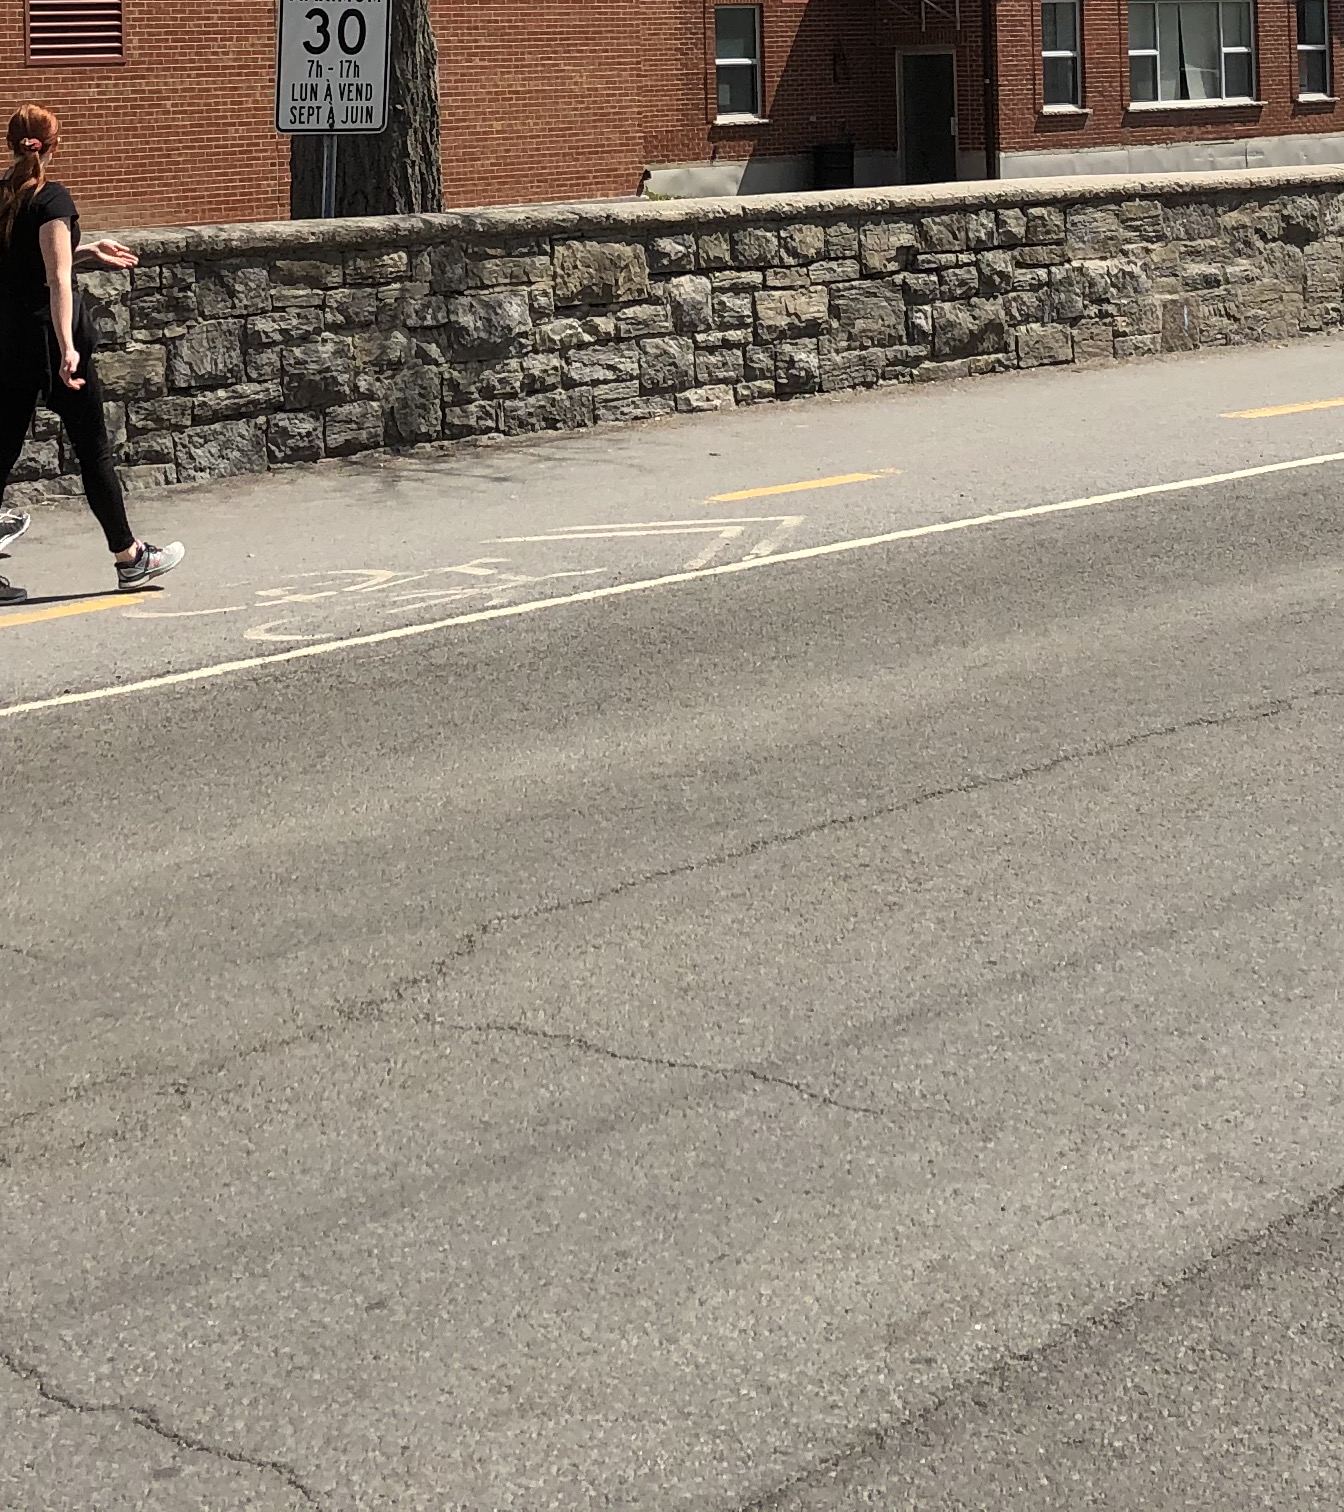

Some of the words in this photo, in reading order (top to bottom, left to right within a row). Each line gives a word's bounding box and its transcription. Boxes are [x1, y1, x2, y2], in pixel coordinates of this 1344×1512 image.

[302, 8, 367, 56] 30
[307, 60, 323, 79] 7h
[339, 60, 360, 79] 17h
[291, 83, 318, 102] LUN
[323, 79, 333, 102] À
[338, 83, 373, 102] VEND
[289, 105, 321, 125] SEPT
[341, 105, 373, 125] JUIN
